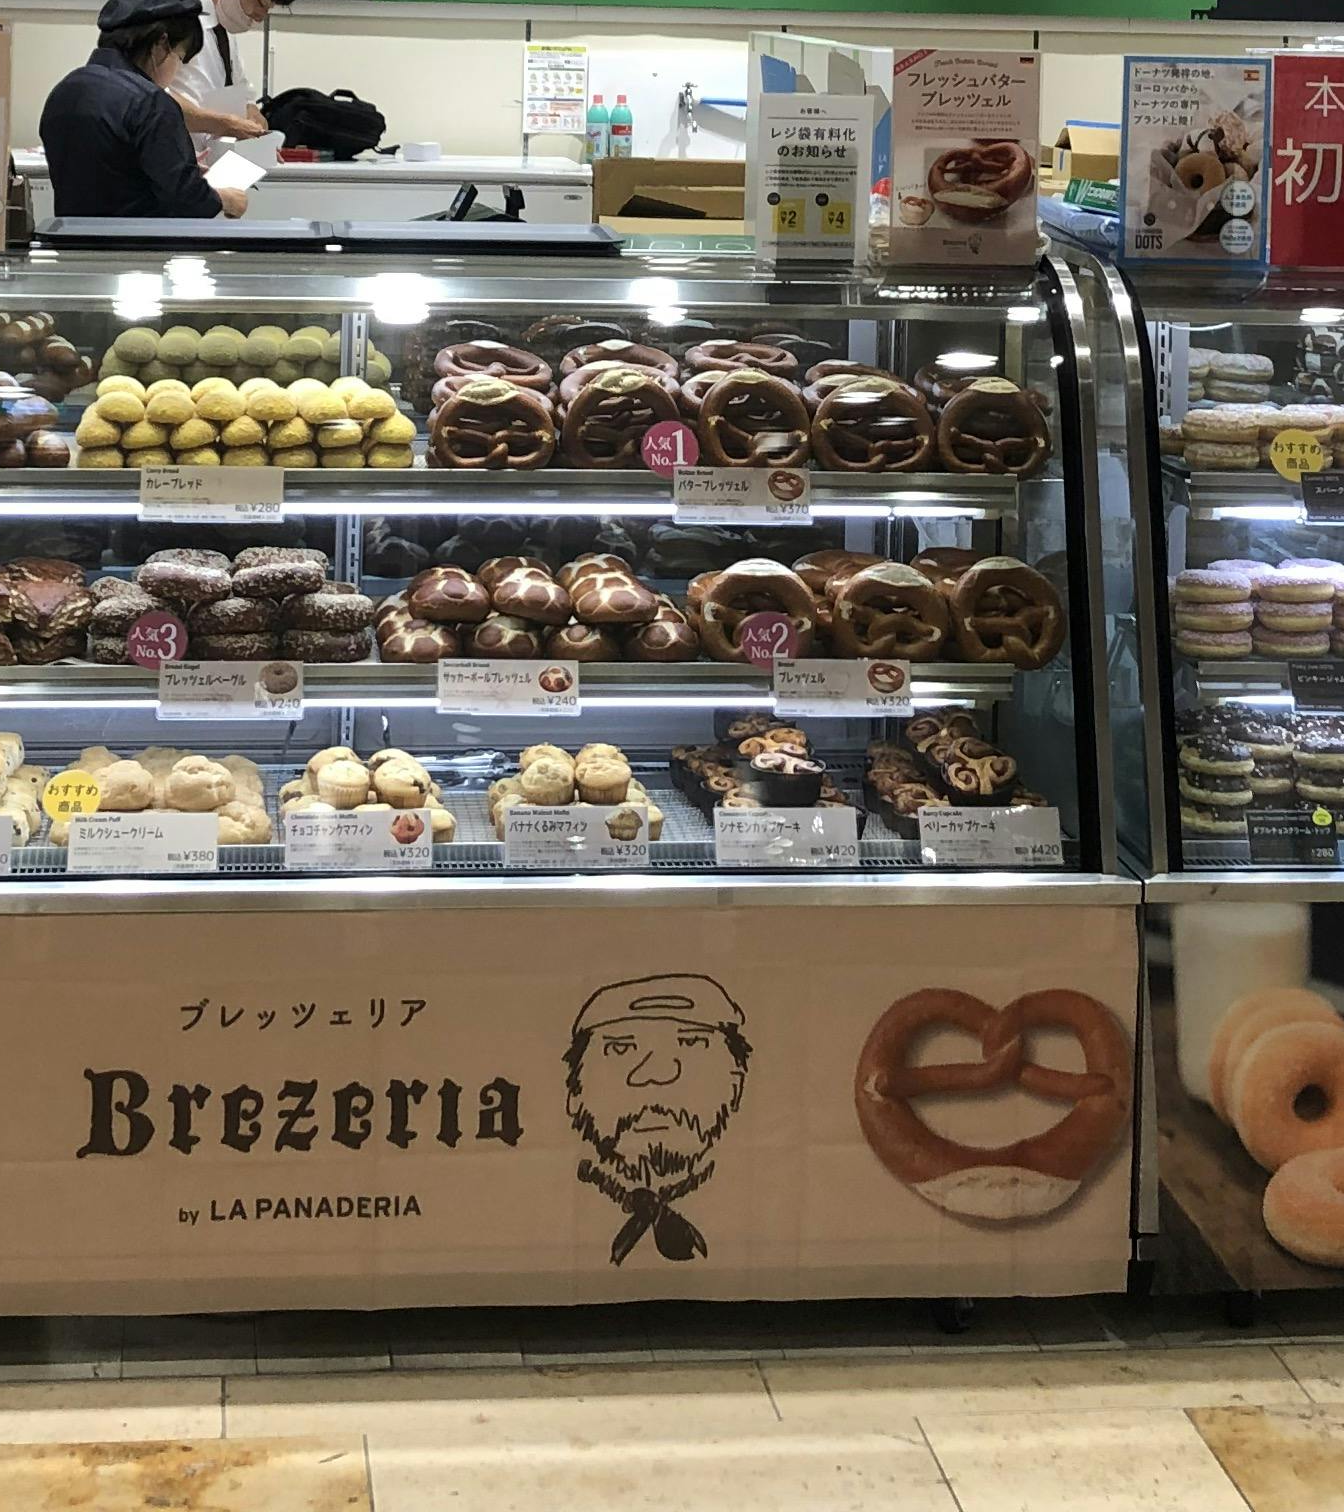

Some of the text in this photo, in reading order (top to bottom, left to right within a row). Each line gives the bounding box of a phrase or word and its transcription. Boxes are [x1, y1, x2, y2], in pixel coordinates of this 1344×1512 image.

[907, 73, 1026, 89] フレッシュバター
[921, 91, 1011, 107] ブレッツェル
[770, 127, 856, 142] レジ袋有料化
[777, 145, 847, 159] のお知らせ
[1135, 234, 1163, 250] DOTS
[645, 436, 672, 450] 人気
[1273, 442, 1321, 455] おすすめ
[146, 478, 203, 489] カレーブレッド
[679, 480, 749, 492] バターブレッツェル
[130, 626, 158, 642] 人気
[744, 628, 772, 642] 人気
[778, 672, 825, 684] ブレッツェル
[47, 783, 98, 797] おすすめ
[58, 801, 82, 813] 商品
[509, 820, 588, 833] バナナくるみマフィン
[924, 820, 996, 832] ベリーカップケーキ
[79, 827, 164, 840] ミルクシュークリーム
[179, 997, 427, 1032] ブレッツェリア
[75, 1067, 525, 1160] Brezeria
[178, 1195, 422, 1226] by LA PANADERIA
